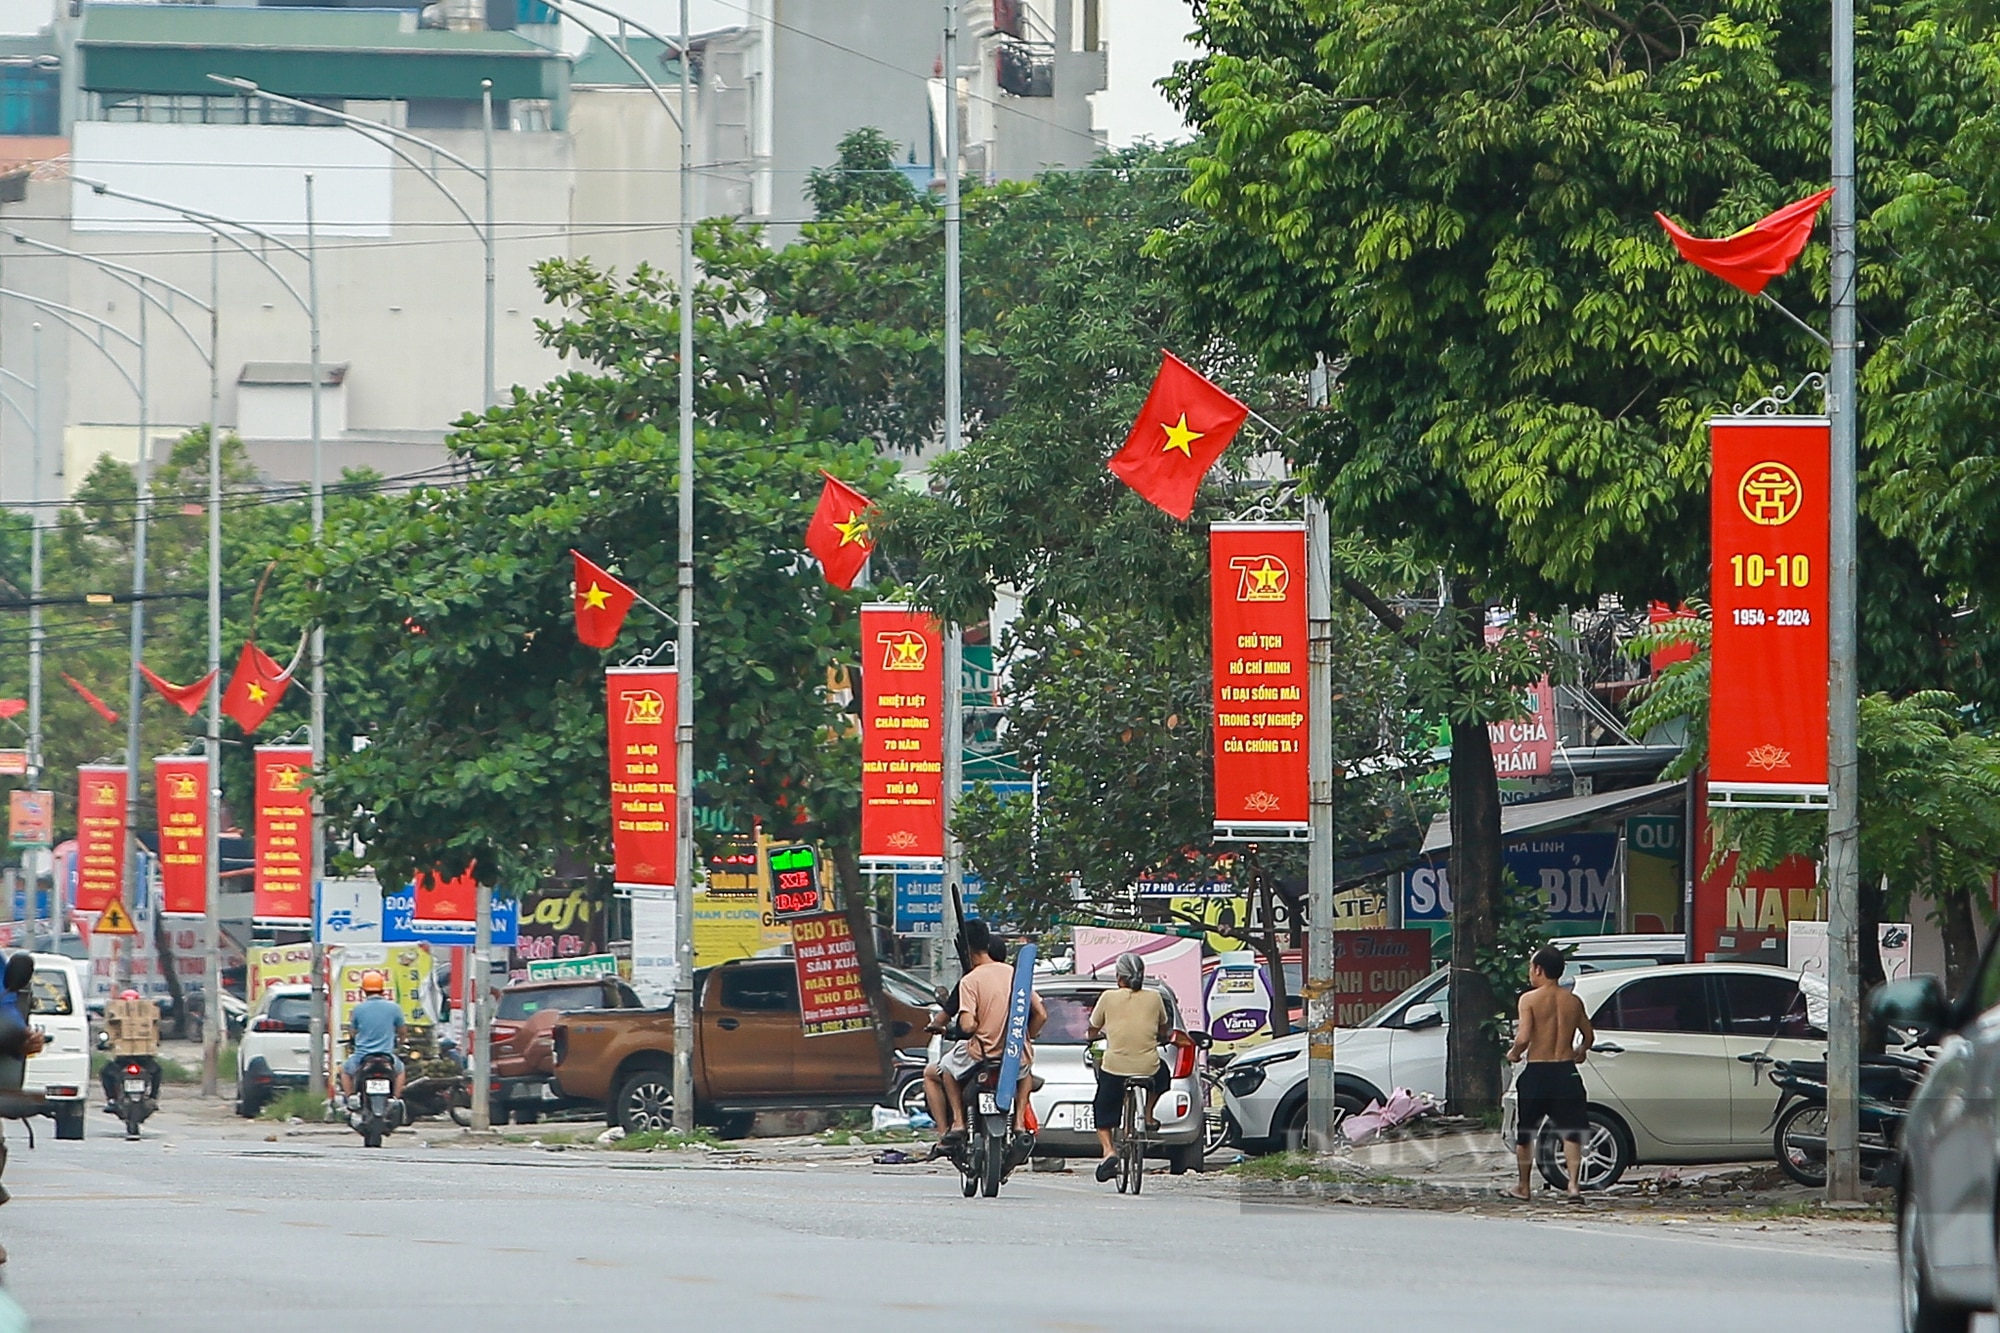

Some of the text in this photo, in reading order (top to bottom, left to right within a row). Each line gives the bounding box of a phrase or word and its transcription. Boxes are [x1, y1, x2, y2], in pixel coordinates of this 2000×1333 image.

[1730, 554, 1809, 587] 10-10
[1733, 609, 1765, 625] 1954
[1776, 609, 1810, 626] 2024
[1238, 632, 1282, 650] CHỦ TỊCH
[1246, 660, 1262, 674] CHÍ
[1264, 662, 1291, 674] MINH
[1252, 684, 1278, 700] SỐNG
[1219, 712, 1303, 729] TRONG SỰ NGHIỆP
[1509, 716, 1547, 743] CHẢ
[1224, 736, 1243, 752] CỦA
[1245, 738, 1279, 752] CHÚNG
[1281, 740, 1292, 752] TA
[1636, 824, 1679, 849] QU
[1532, 842, 1566, 853] LINH
[779, 872, 810, 889] XE
[776, 891, 817, 912] ĐẠP
[794, 921, 826, 942] CHO
[828, 919, 850, 938] TH
